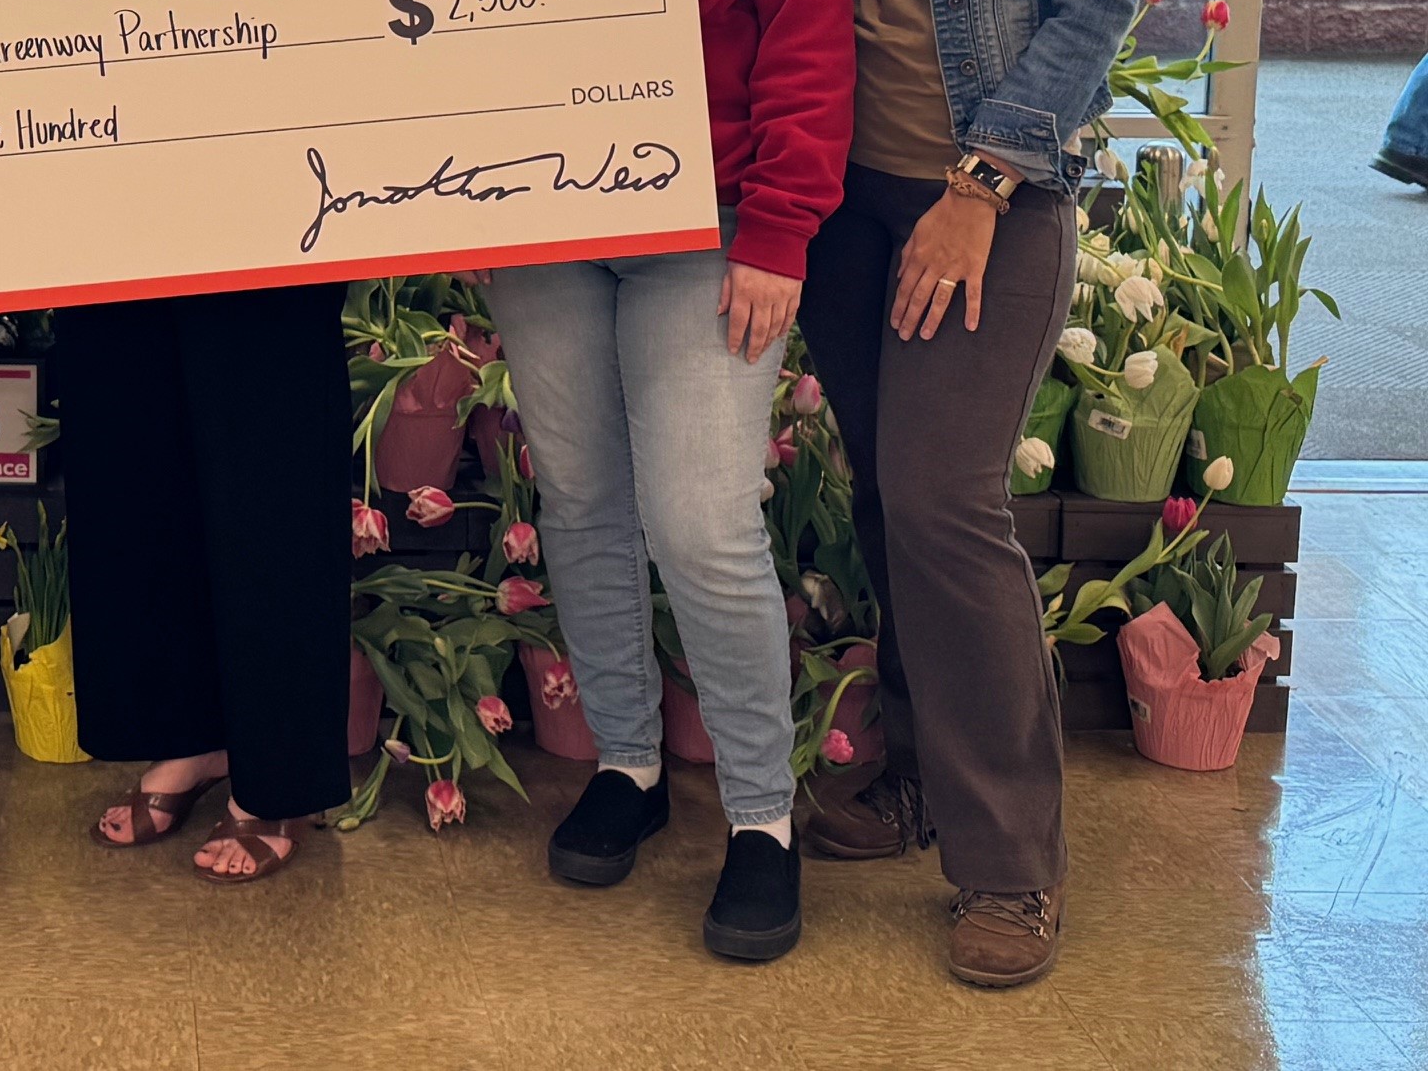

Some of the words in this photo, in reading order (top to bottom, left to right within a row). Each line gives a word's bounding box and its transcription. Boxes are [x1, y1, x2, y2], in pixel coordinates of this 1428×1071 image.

[114, 9, 277, 60] Partnership
[571, 79, 674, 106] DOLLARS
[16, 105, 119, 150] Hundred
